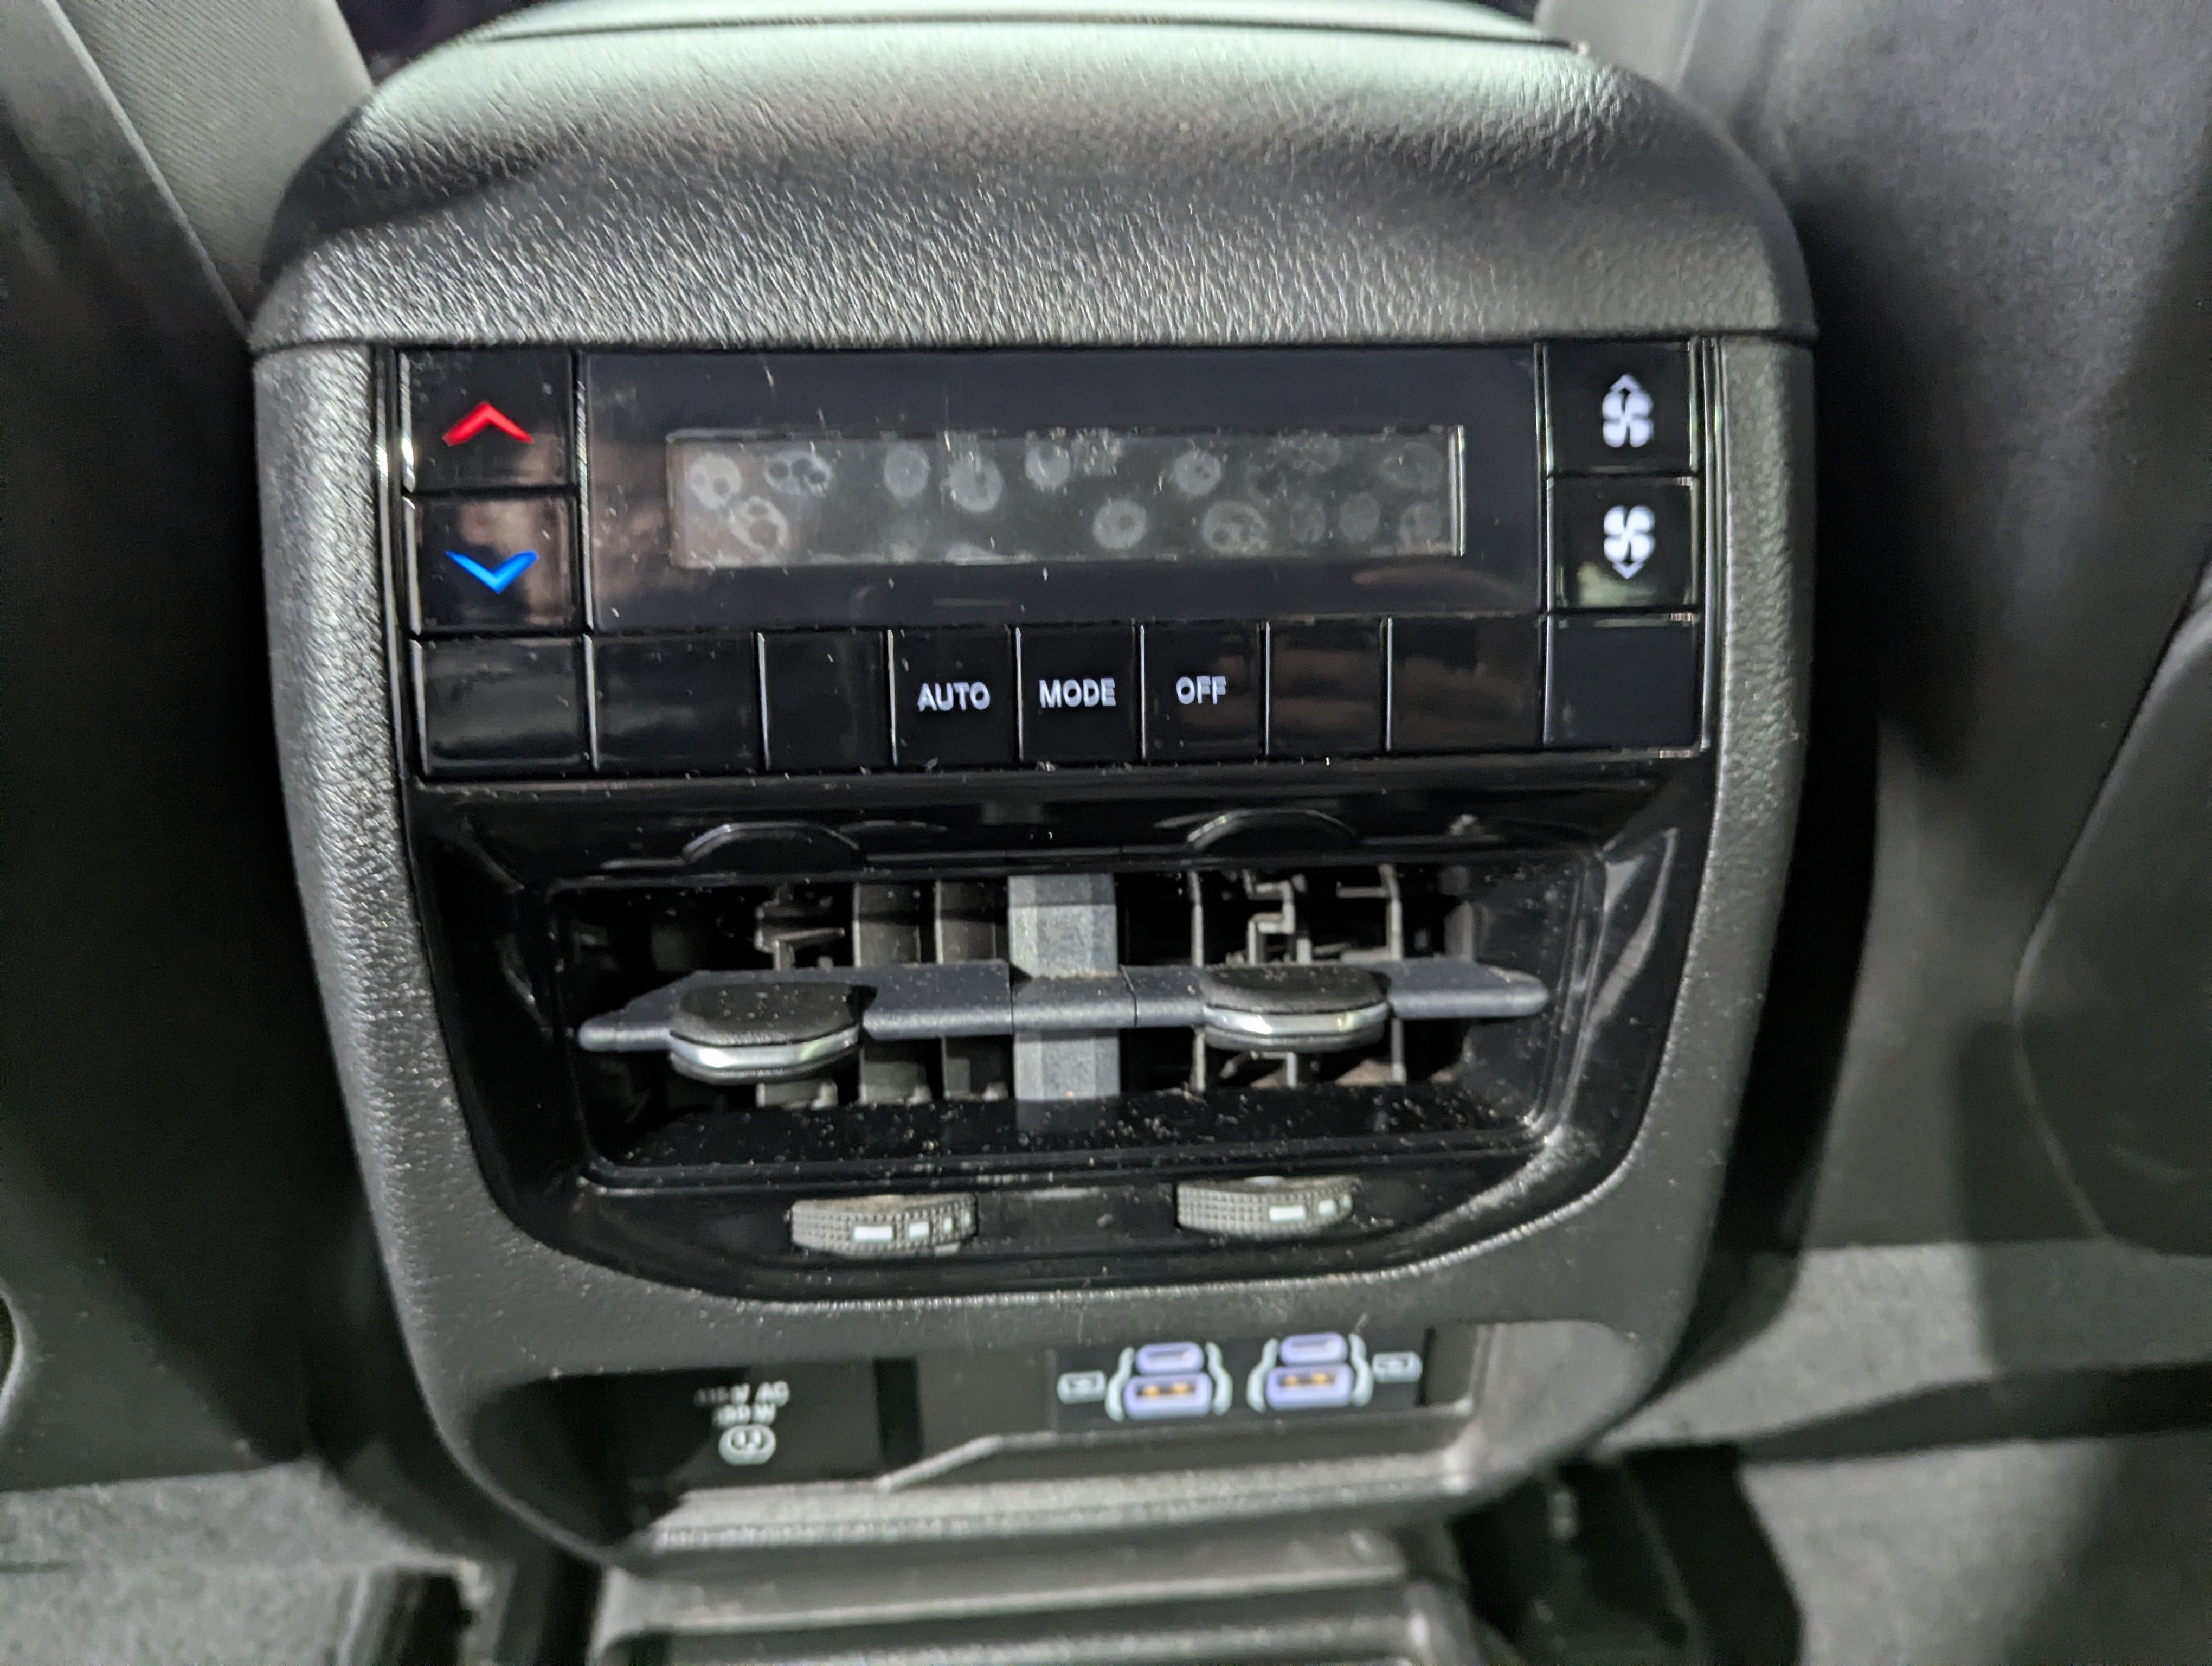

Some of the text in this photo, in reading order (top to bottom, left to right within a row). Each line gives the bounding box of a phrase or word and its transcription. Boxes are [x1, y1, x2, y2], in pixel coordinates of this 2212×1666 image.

[918, 682, 991, 711] AUTO
[1039, 678, 1116, 708] MODE
[1176, 676, 1227, 705] OFF
